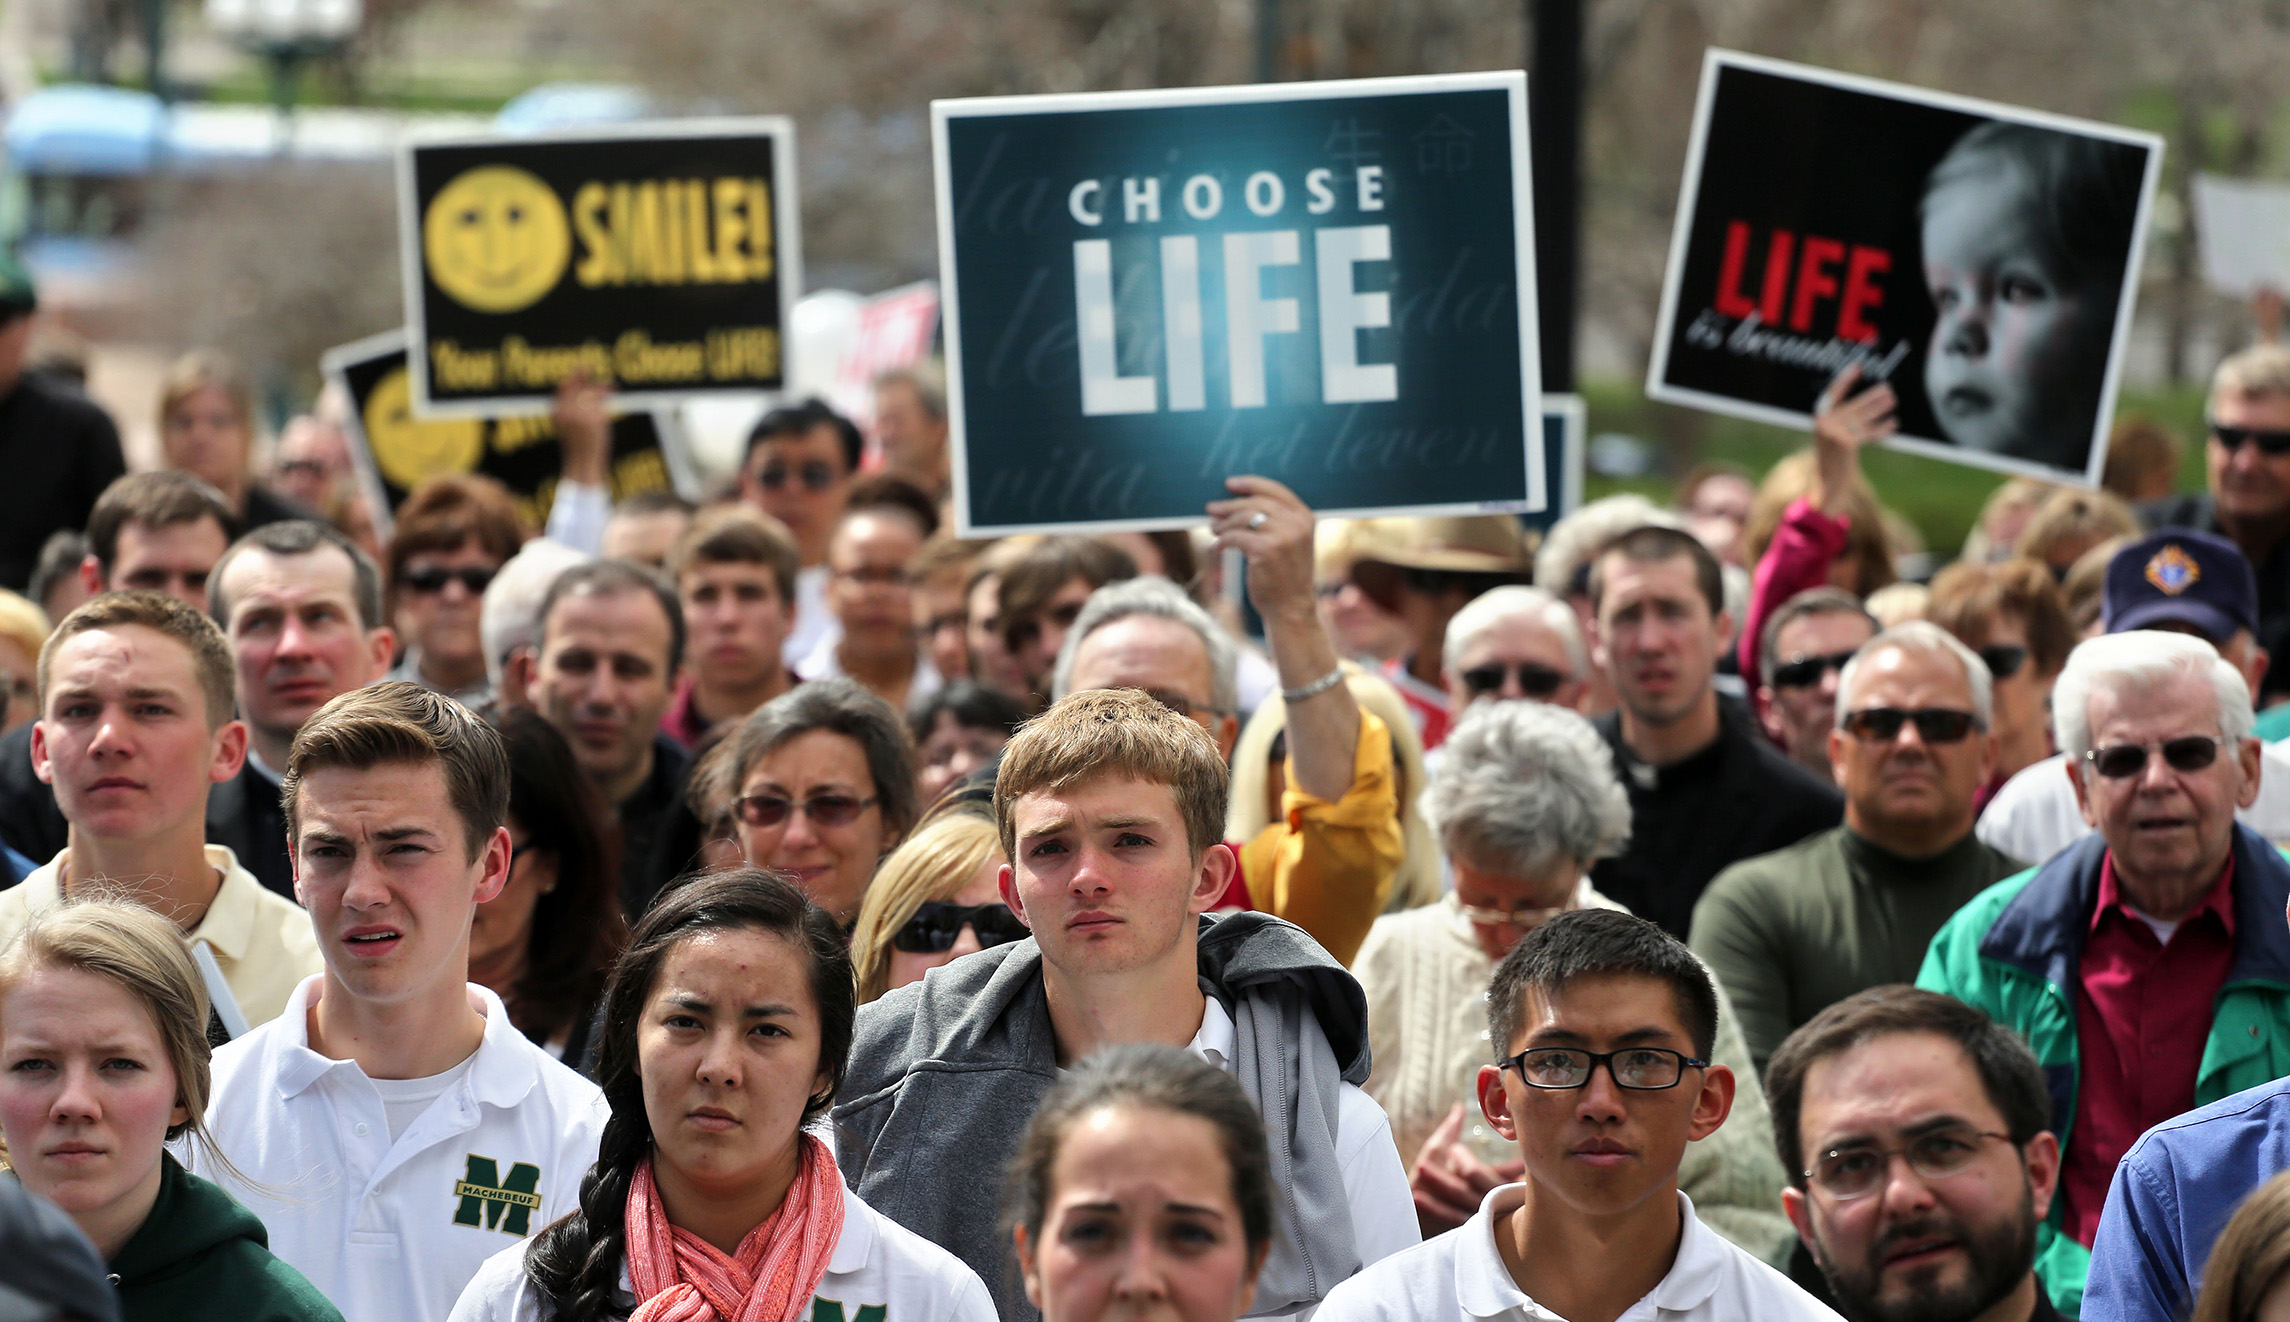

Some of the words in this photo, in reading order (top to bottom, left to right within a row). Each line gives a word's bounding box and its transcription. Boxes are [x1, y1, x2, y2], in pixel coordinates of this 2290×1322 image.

[572, 175, 773, 288] SMILE!
[1069, 164, 1386, 226] CHOOSE
[1073, 225, 1398, 417] LIFE
[1714, 220, 1892, 346] LIFE
[1685, 308, 1726, 349] is
[462, 1186, 533, 1205] MACHEBEUF
